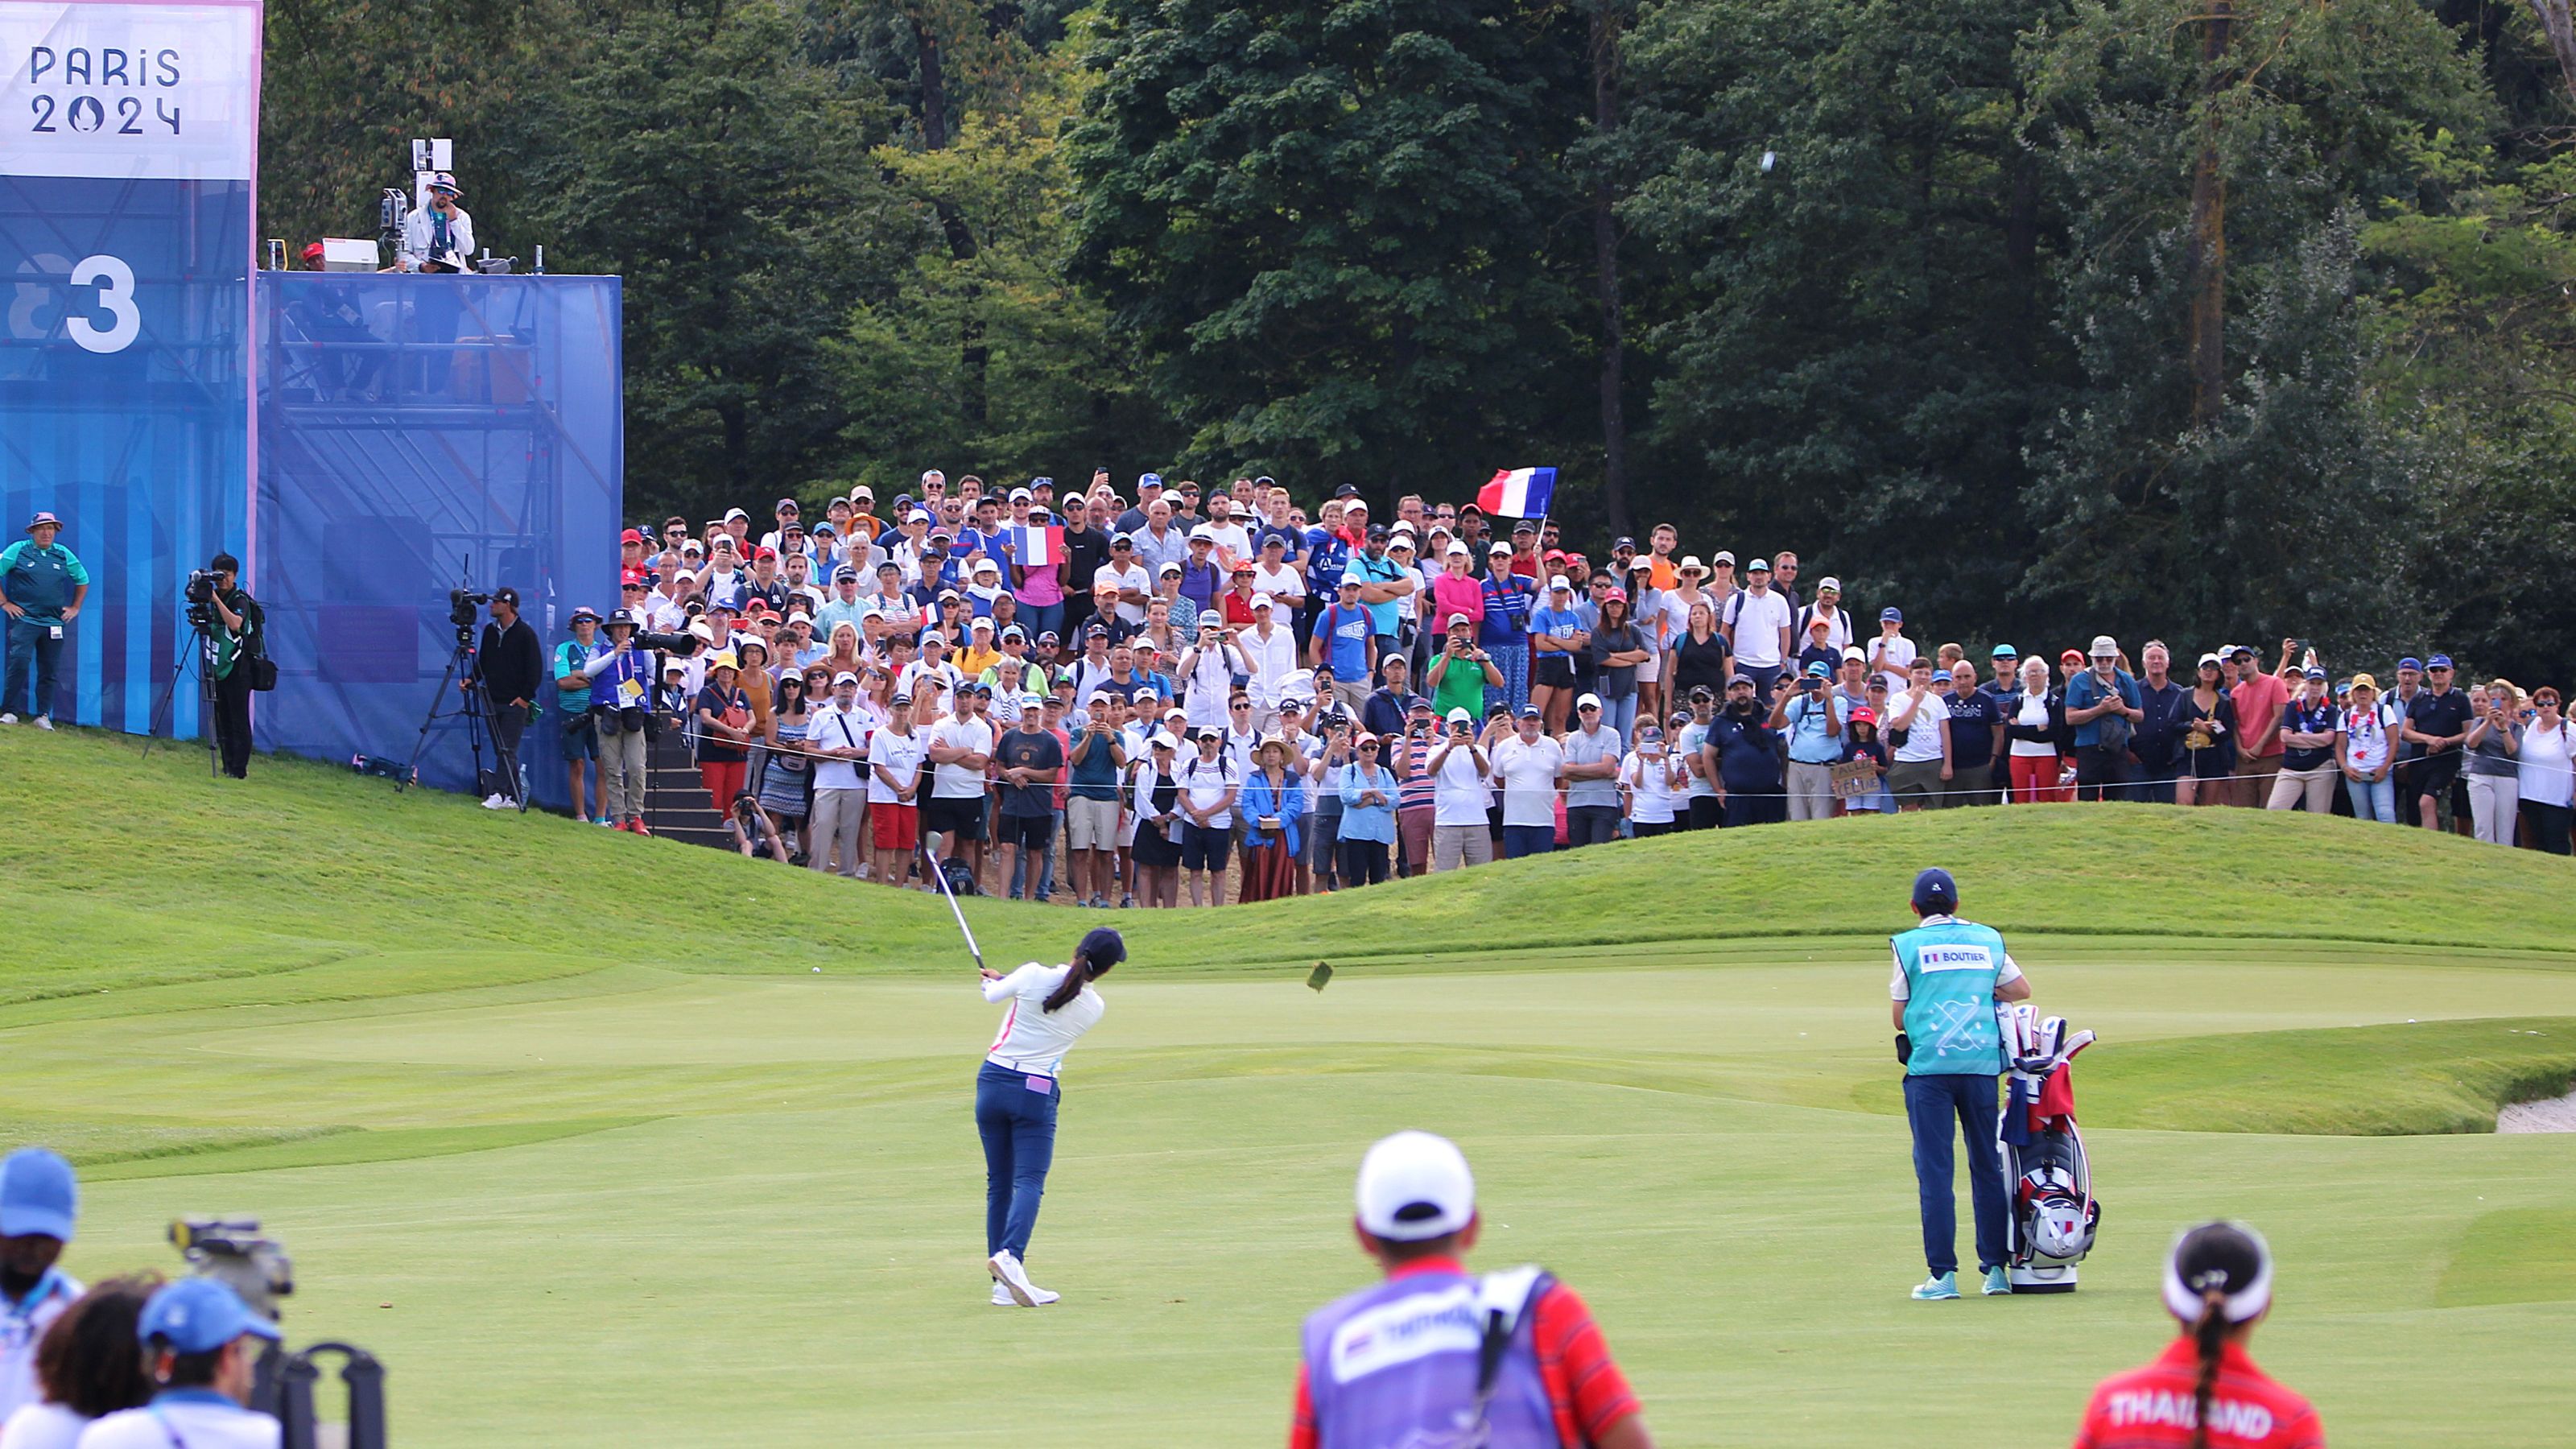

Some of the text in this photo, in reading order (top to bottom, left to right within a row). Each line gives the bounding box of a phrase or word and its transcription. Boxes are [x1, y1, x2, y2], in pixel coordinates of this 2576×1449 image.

[31, 93, 180, 135] 2024
[66, 254, 141, 354] 3
[1942, 952, 1986, 962] BOUTIER
